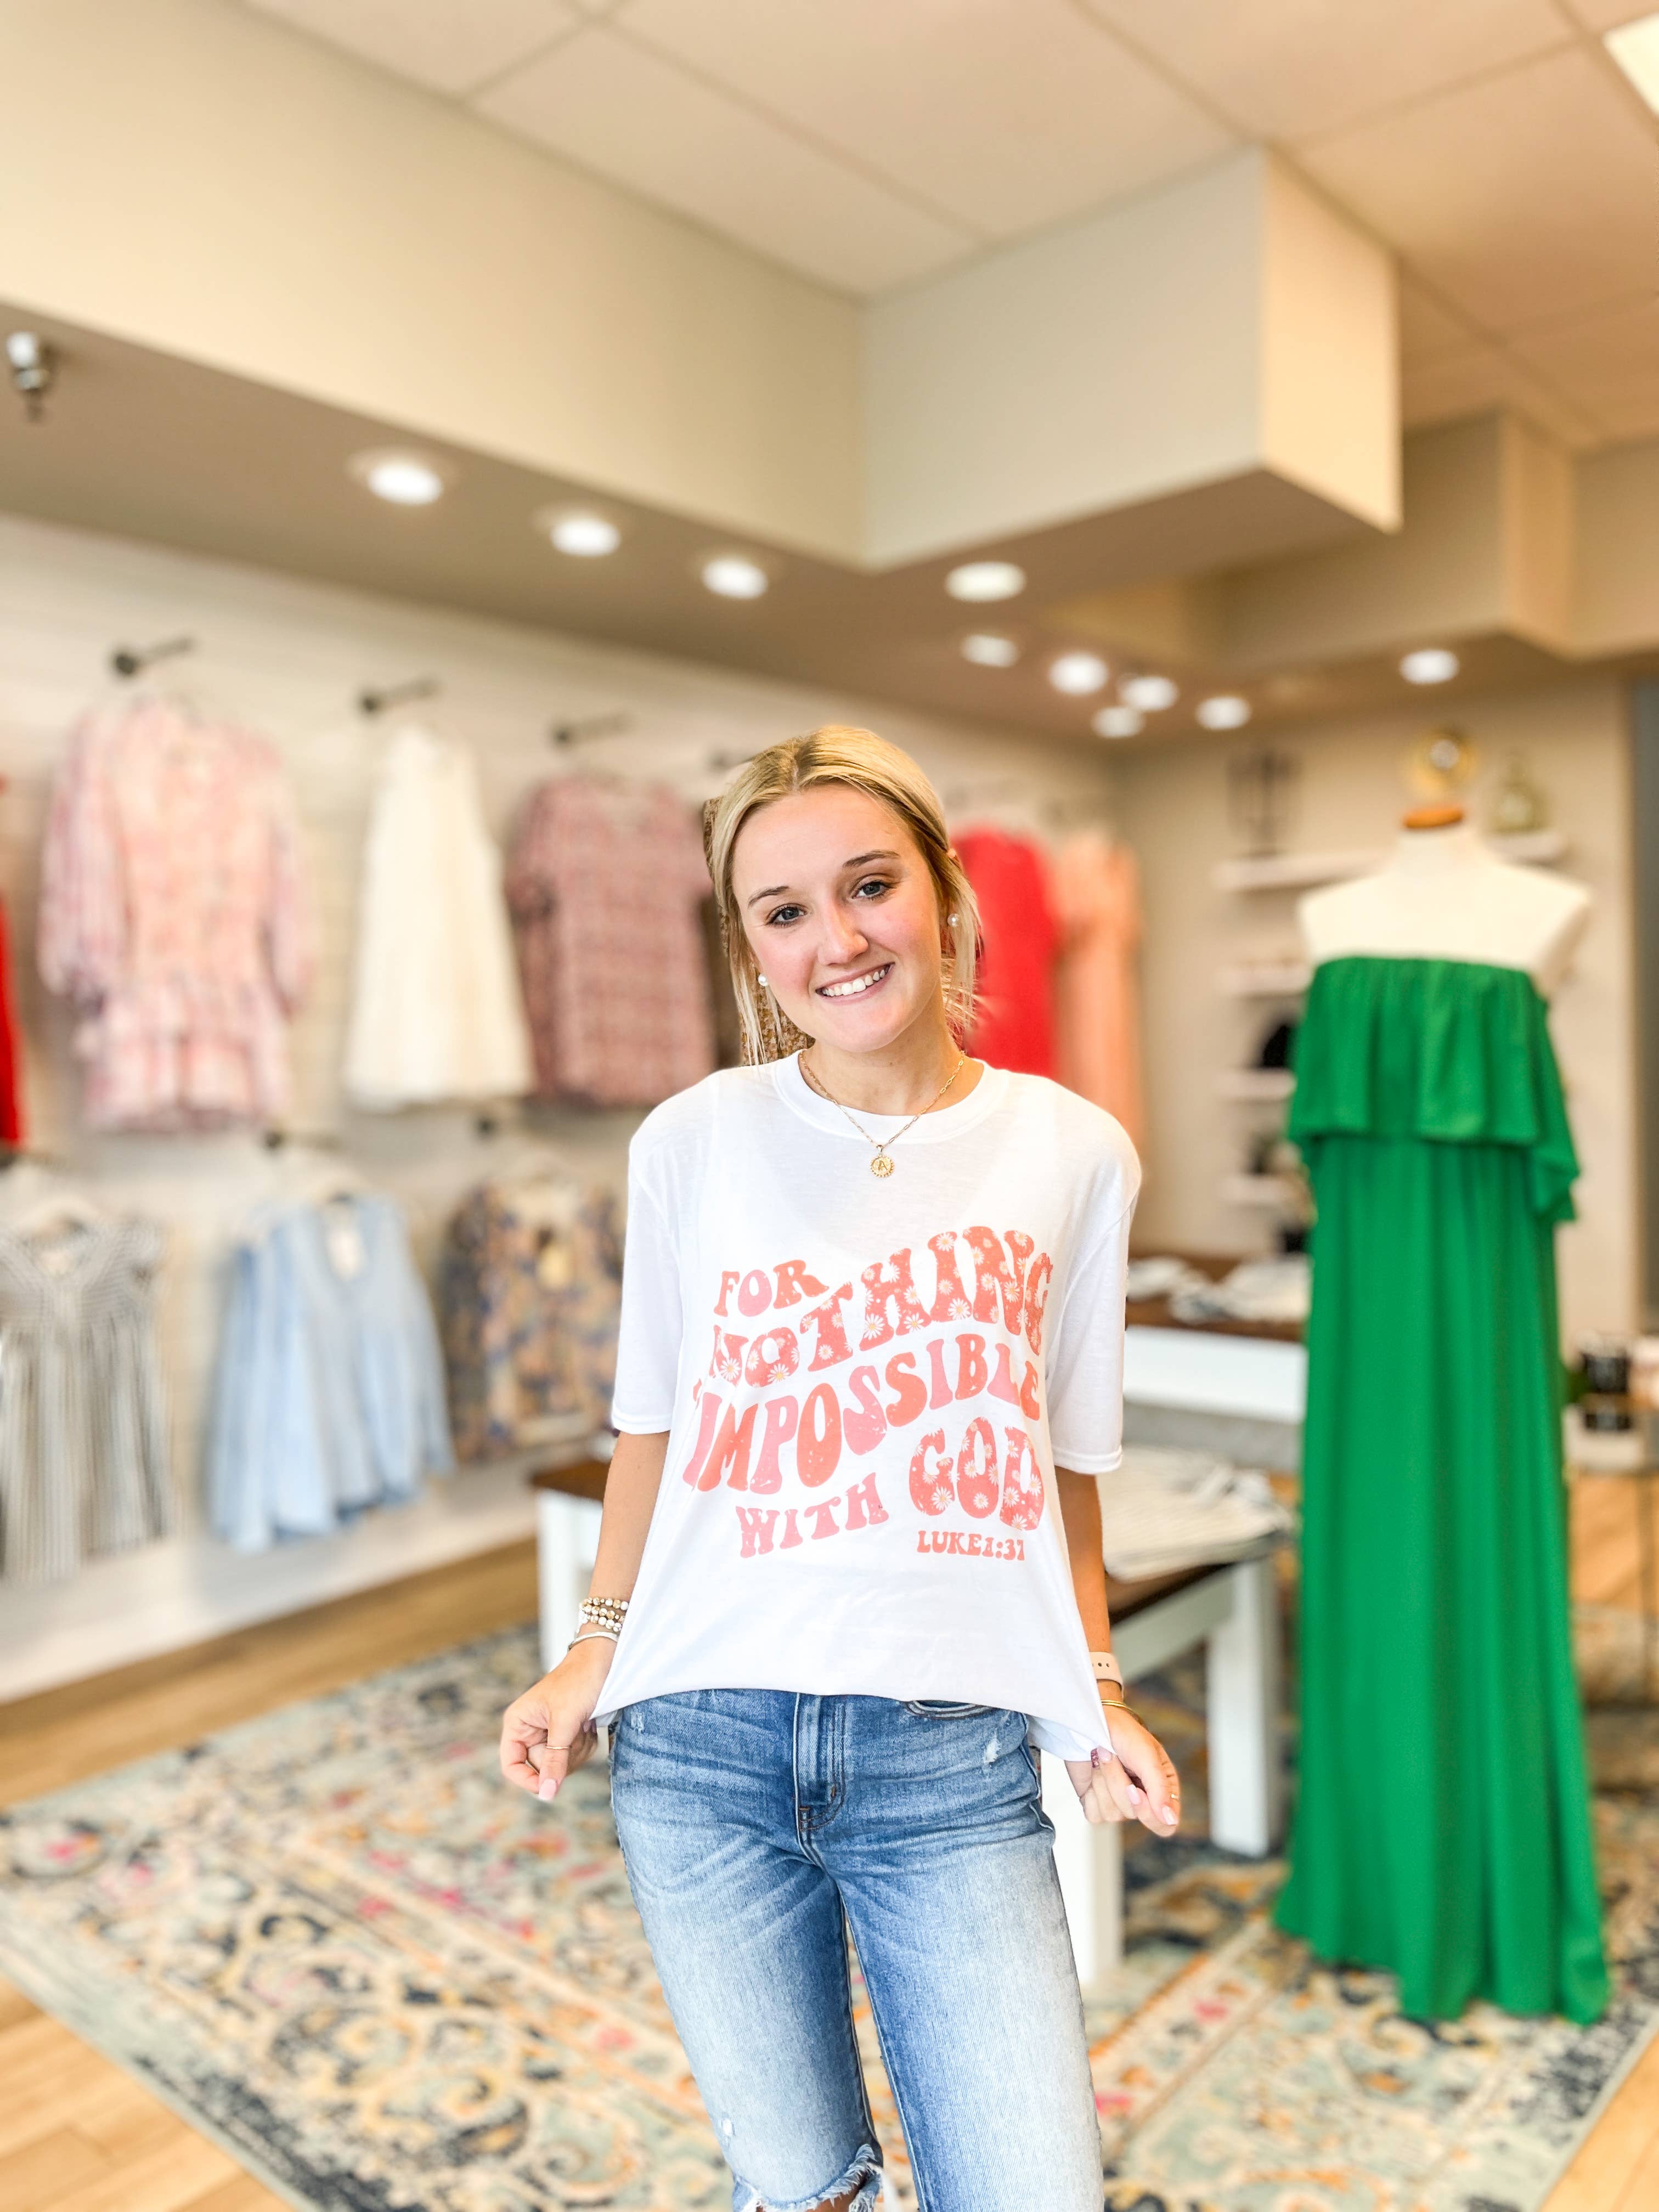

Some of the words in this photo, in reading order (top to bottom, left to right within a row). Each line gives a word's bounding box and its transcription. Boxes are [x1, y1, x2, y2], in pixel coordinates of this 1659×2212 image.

[709, 1226, 1054, 1387] NOTHING
[714, 1259, 830, 1318] FOR
[682, 1333, 1041, 1495] IMPOSSIBLE
[736, 1472, 889, 1558] WITH
[909, 1417, 1045, 1531] GOD
